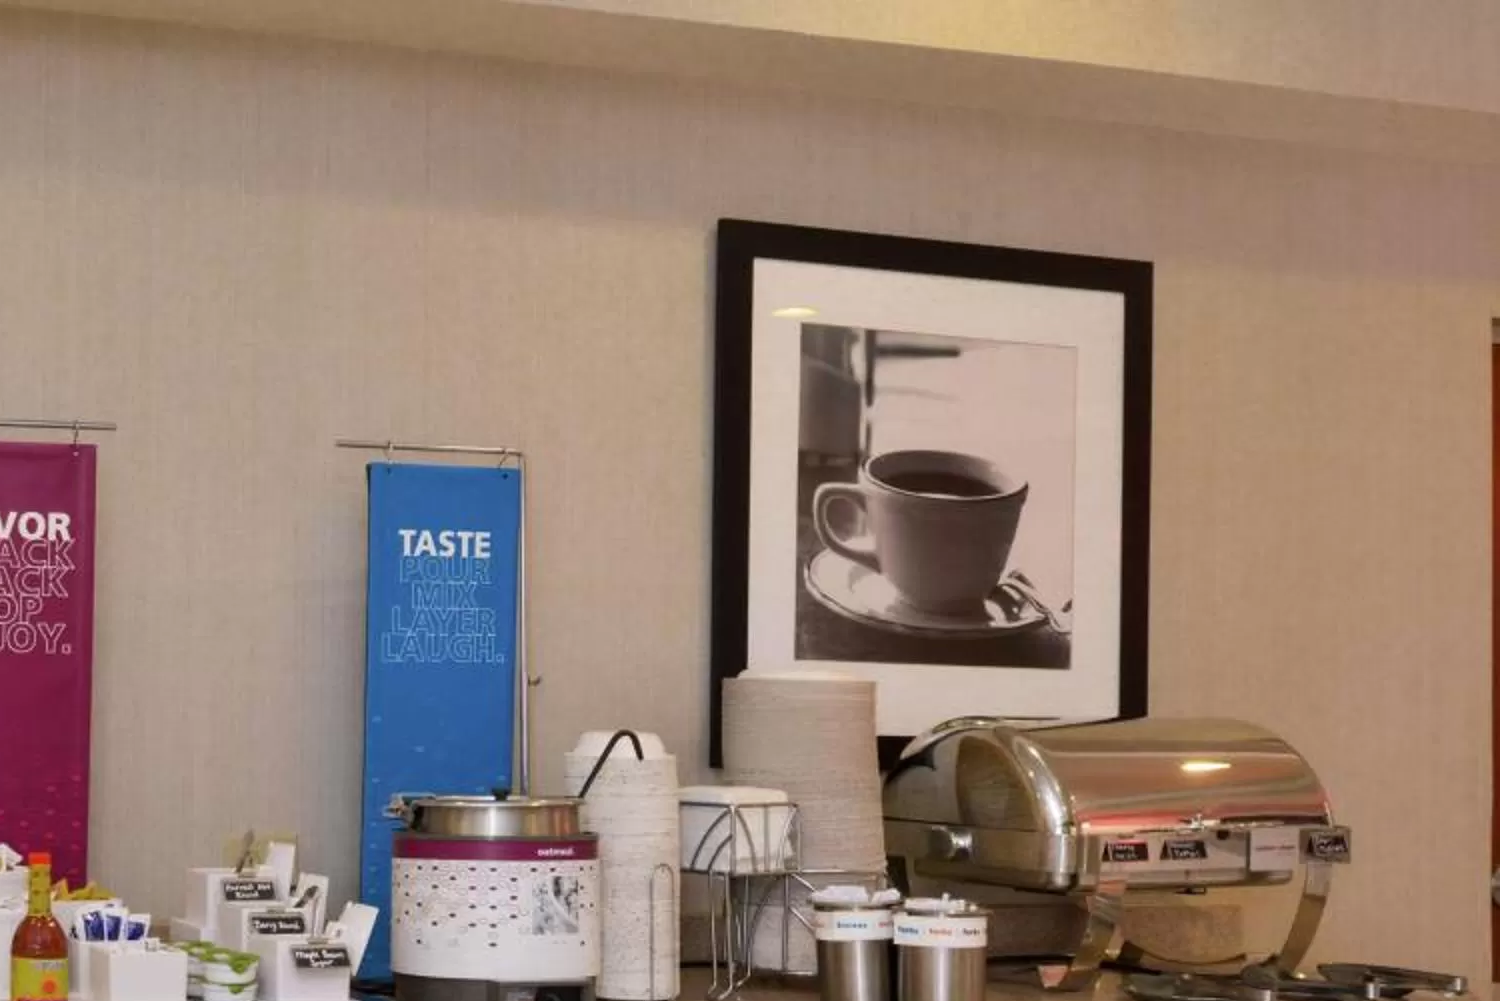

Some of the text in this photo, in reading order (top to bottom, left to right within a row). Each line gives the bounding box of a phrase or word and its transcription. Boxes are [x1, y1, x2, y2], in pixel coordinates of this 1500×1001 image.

[397, 528, 492, 559] TASTE
[398, 557, 493, 585] POUR
[411, 579, 478, 611] MIX
[390, 605, 497, 637] LAYER
[380, 631, 506, 664] LAUGH.
